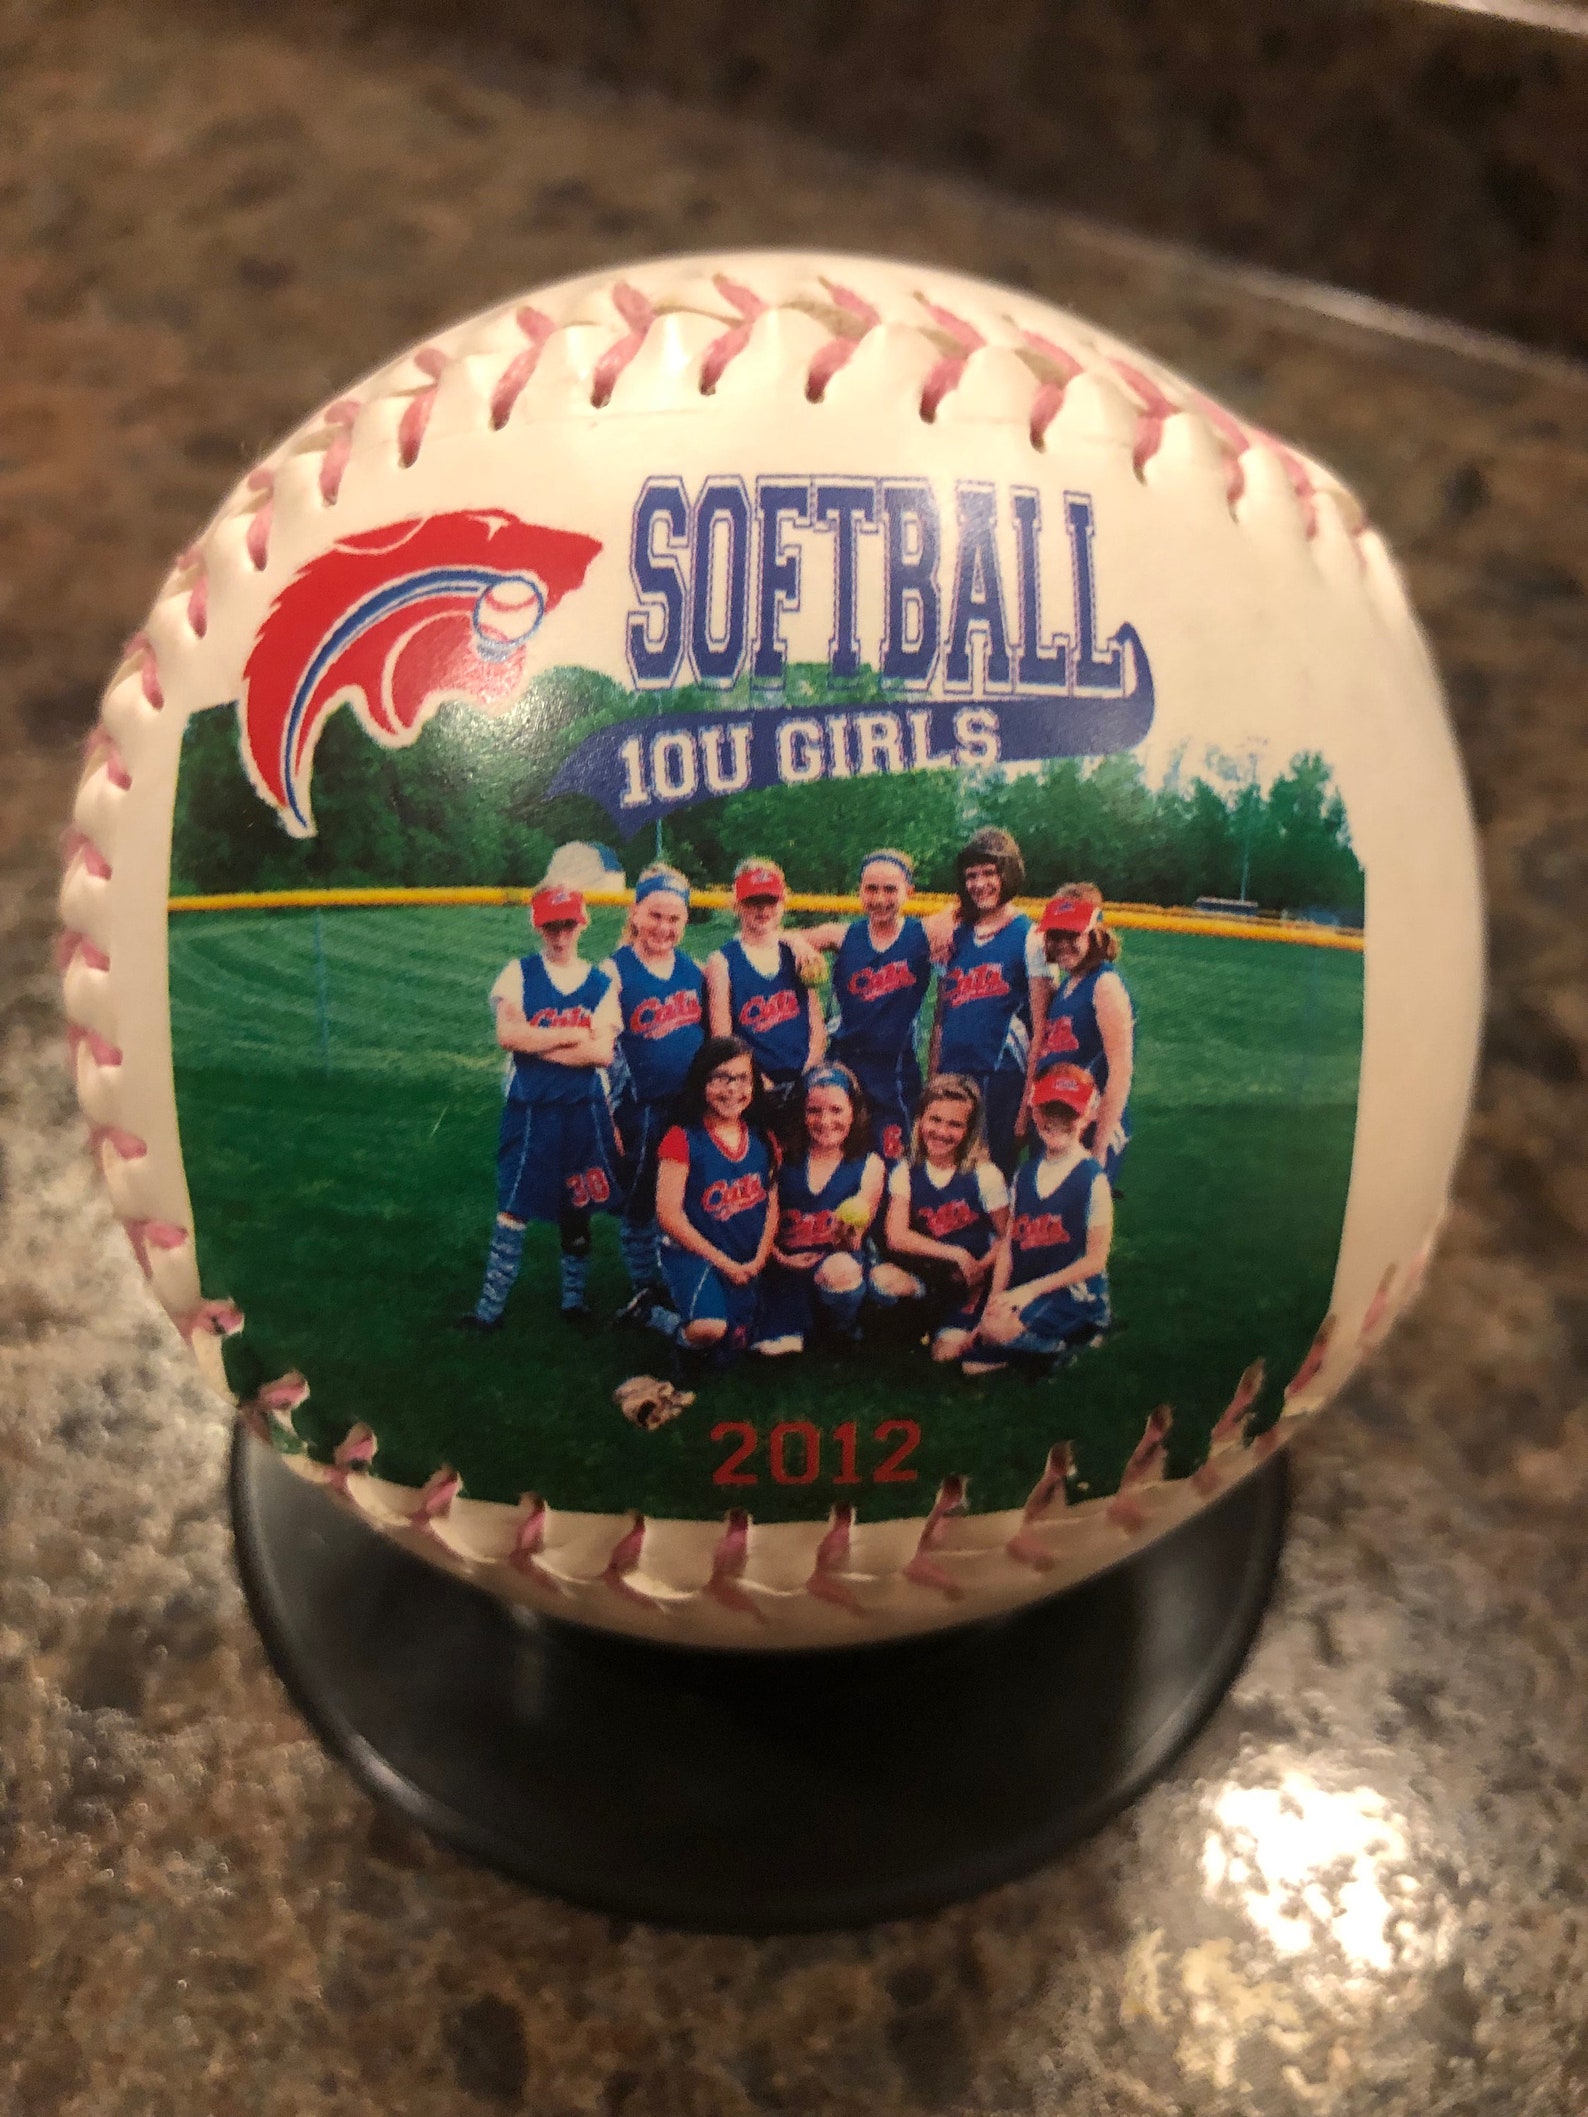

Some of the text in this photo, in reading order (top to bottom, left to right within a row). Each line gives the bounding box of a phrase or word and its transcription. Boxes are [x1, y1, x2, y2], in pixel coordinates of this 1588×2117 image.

[625, 474, 1127, 697] SOFTBALL
[619, 707, 1001, 810] 10U GIRLS
[566, 1167, 611, 1209] 30
[708, 1419, 922, 1486] 2012
